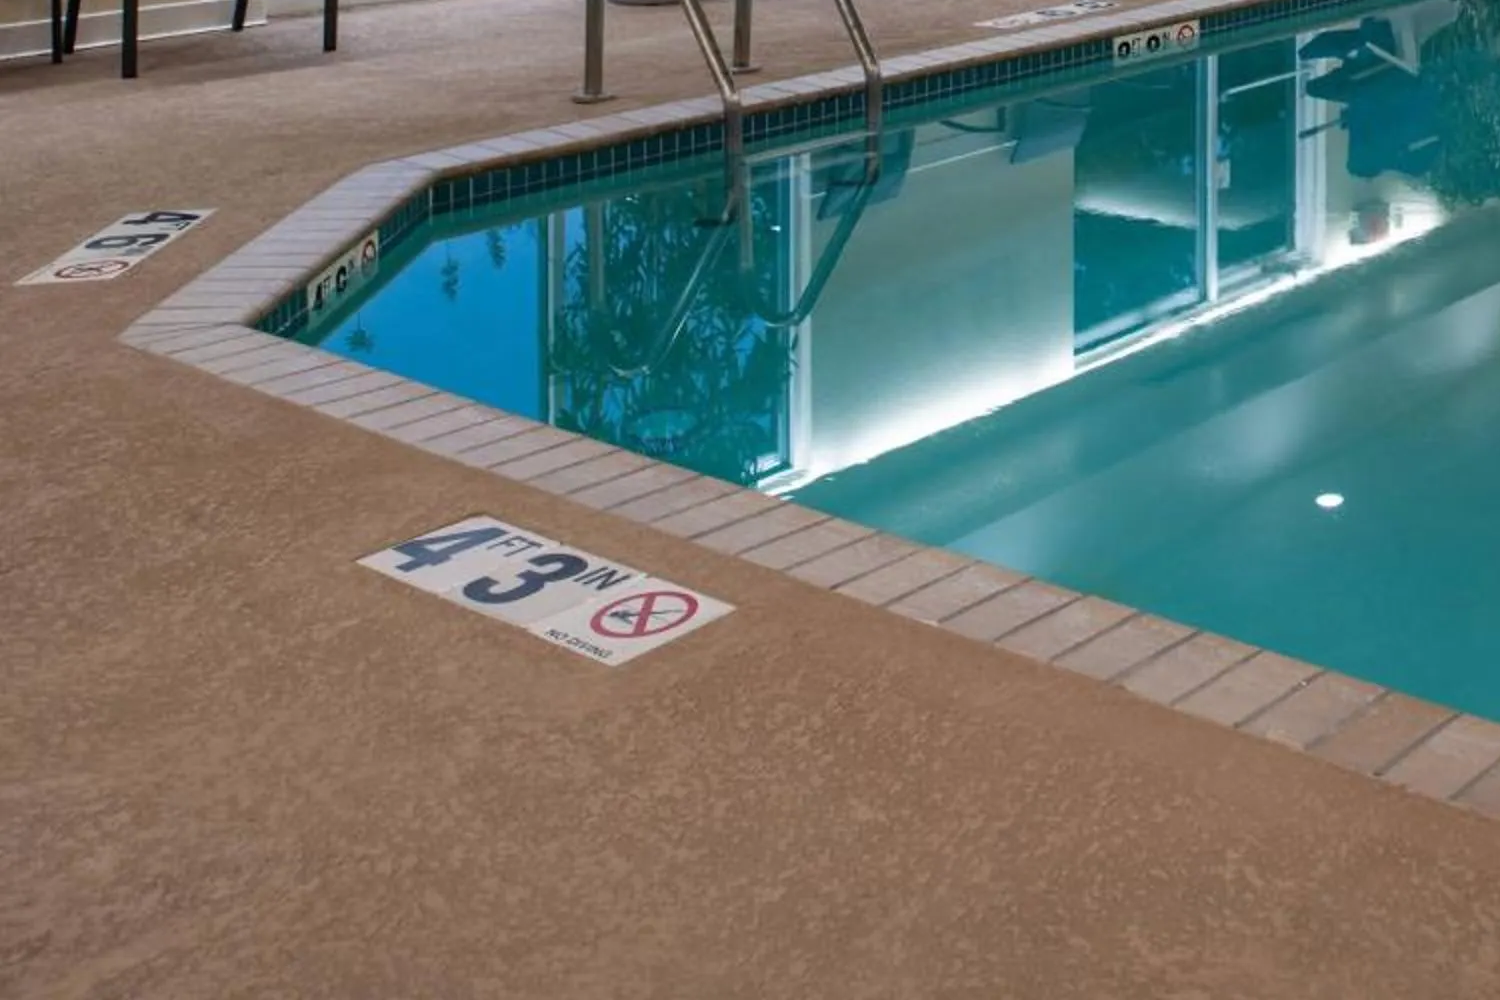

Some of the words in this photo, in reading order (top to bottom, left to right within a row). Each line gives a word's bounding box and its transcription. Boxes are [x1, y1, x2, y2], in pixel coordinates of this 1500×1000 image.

[122, 211, 200, 226] 4
[85, 233, 172, 250] 6
[391, 527, 511, 573] 4
[486, 536, 543, 557] FT
[463, 553, 589, 605] 3
[572, 566, 633, 591] IN
